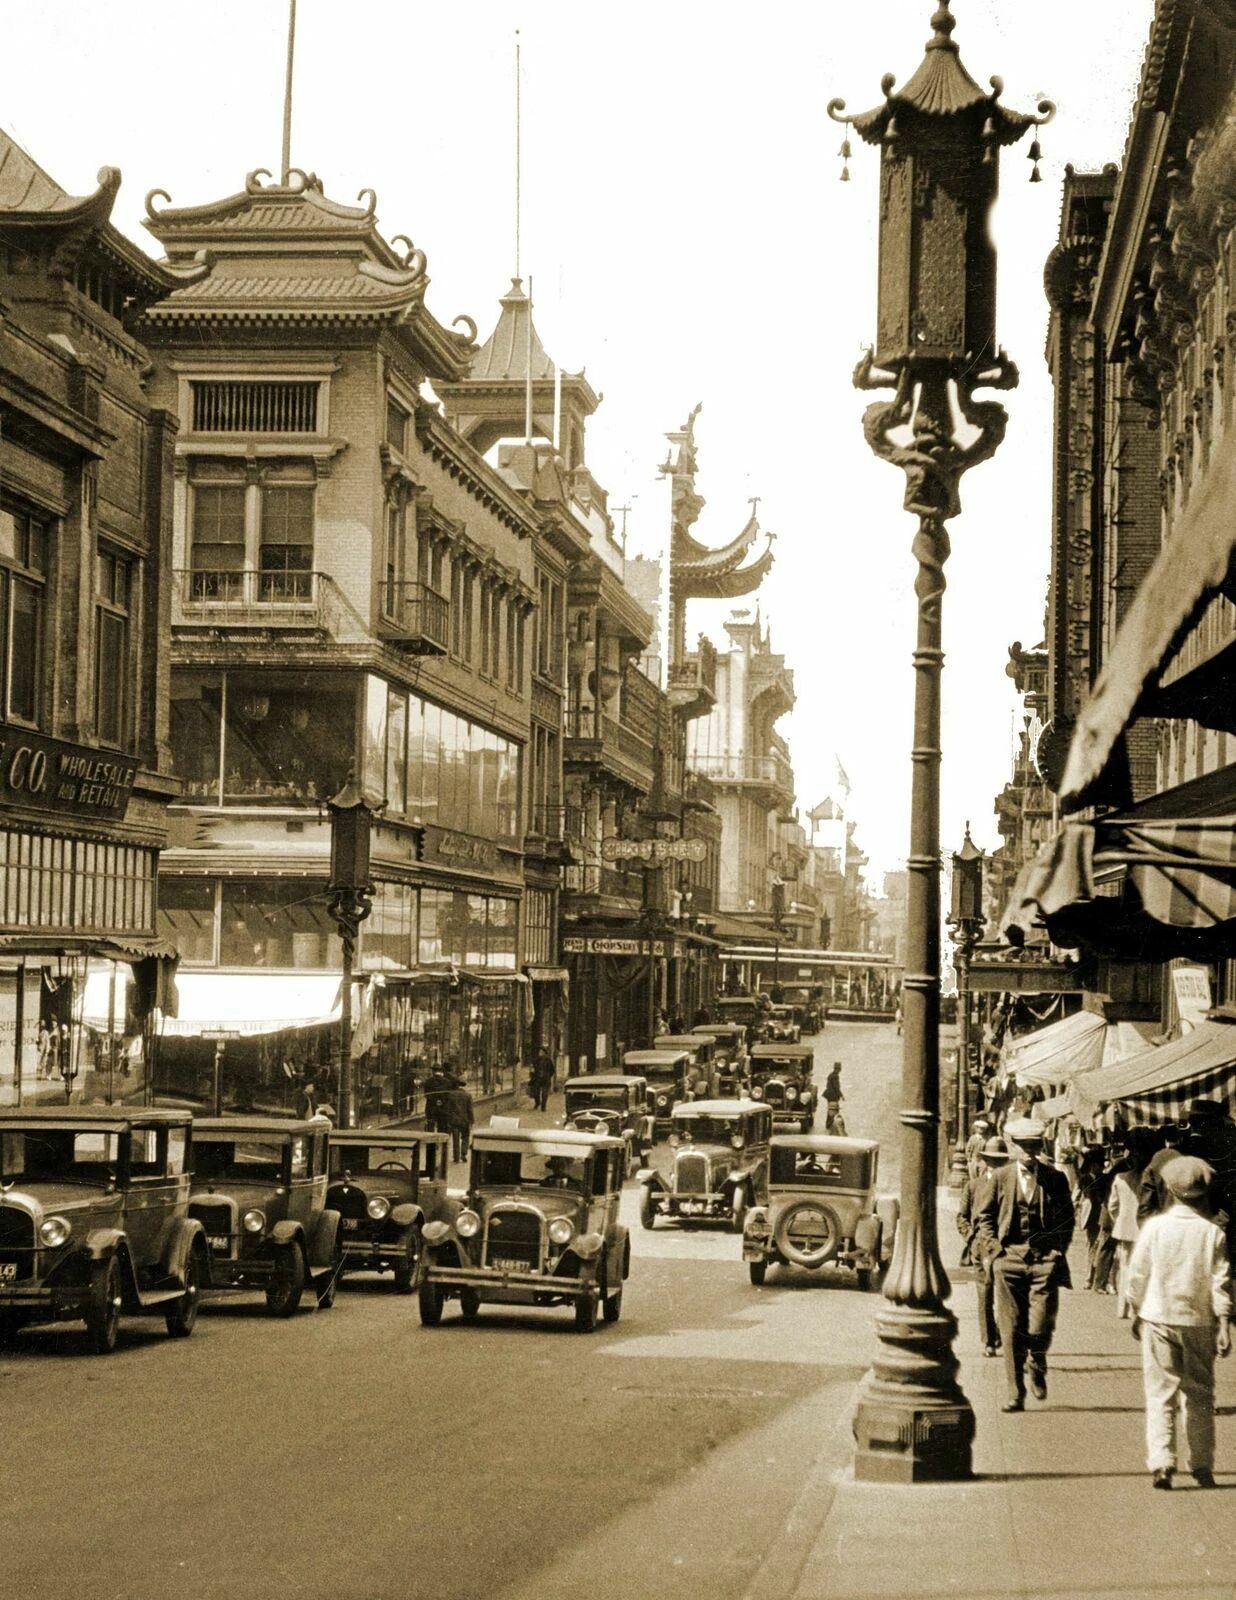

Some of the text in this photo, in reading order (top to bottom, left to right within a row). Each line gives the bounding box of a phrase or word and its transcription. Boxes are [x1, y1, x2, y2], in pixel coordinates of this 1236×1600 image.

[1066, 331, 1095, 703] CHOP SUEY
[60, 754, 134, 788] WHOLESALE
[59, 783, 120, 808] AND RETAIL
[656, 843, 704, 857] SUEY
